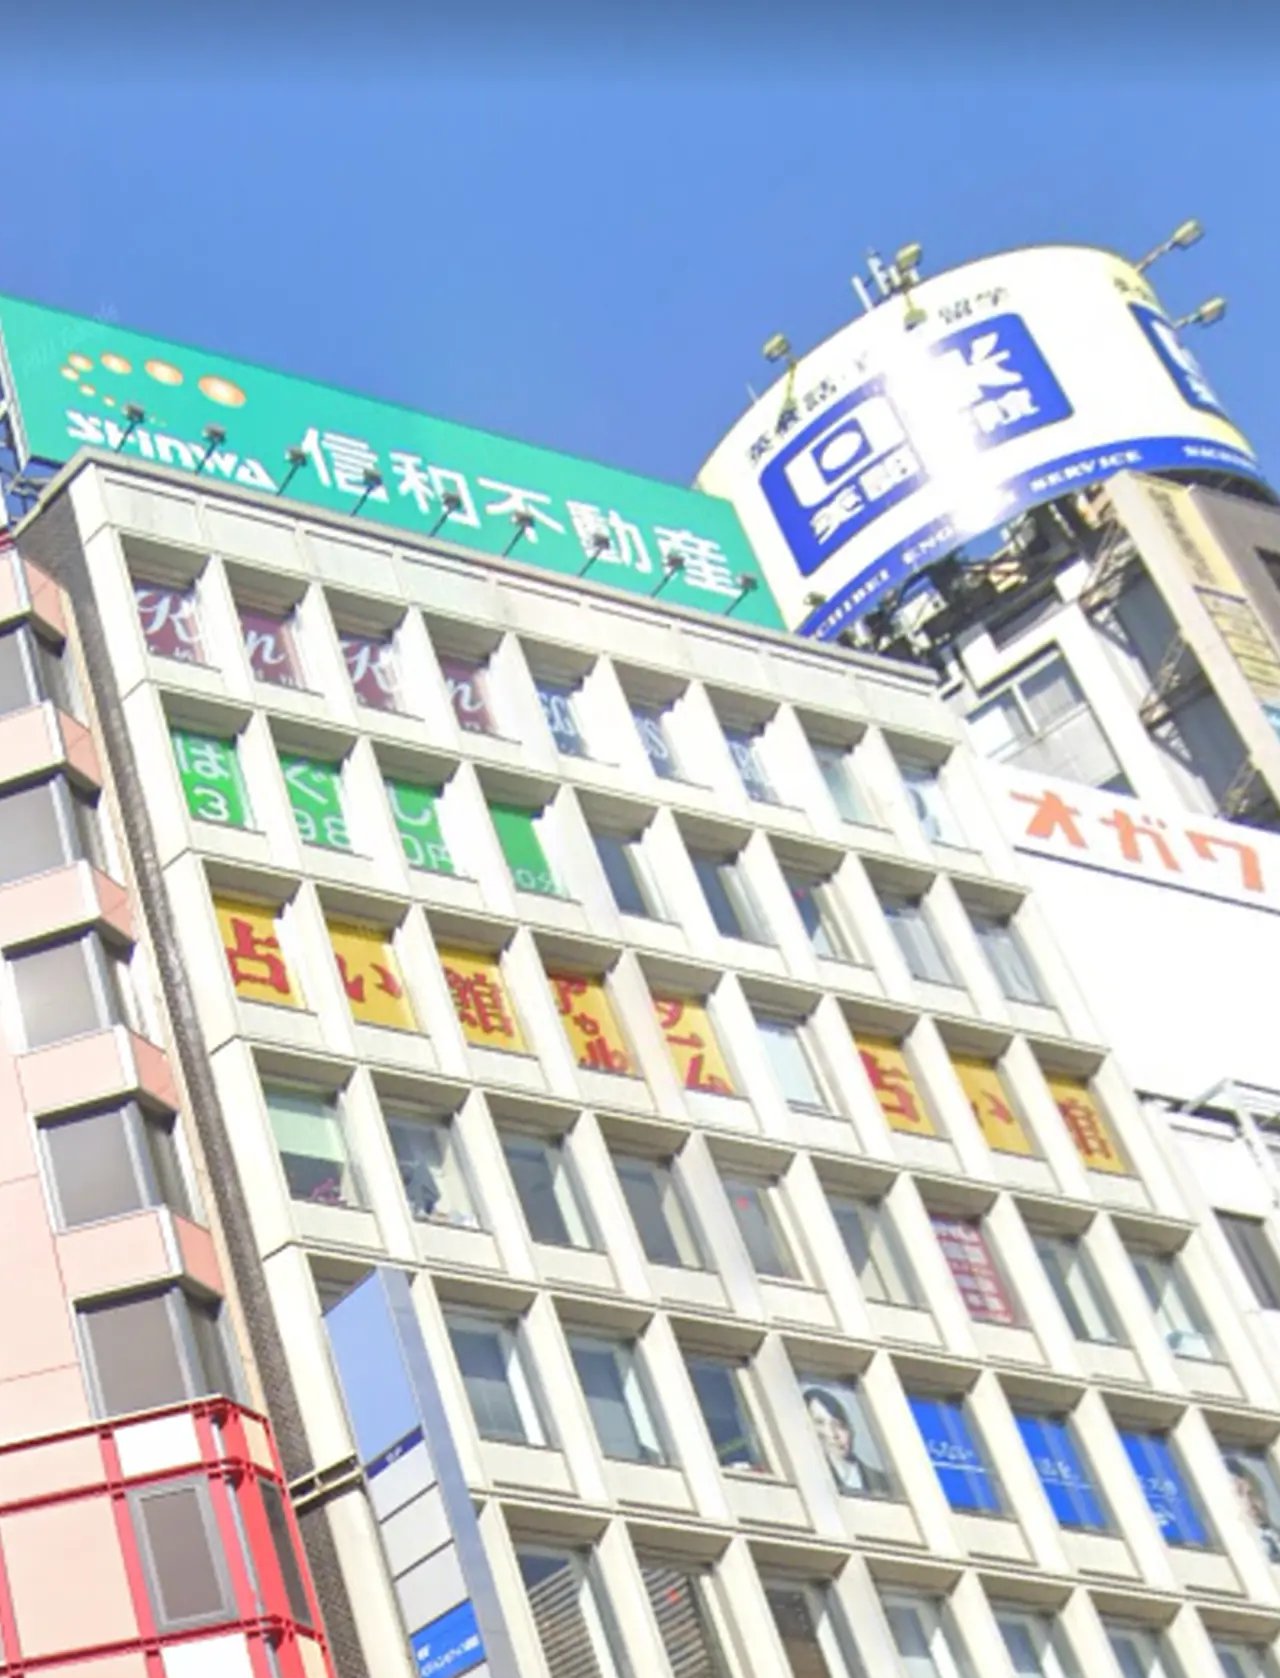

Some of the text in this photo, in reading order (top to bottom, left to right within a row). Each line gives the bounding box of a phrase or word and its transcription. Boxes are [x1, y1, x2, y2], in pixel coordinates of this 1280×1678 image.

[302, 427, 742, 600] 信和不動産
[1030, 450, 1143, 493] SERVICE
[1008, 789, 1266, 894] オガワ
